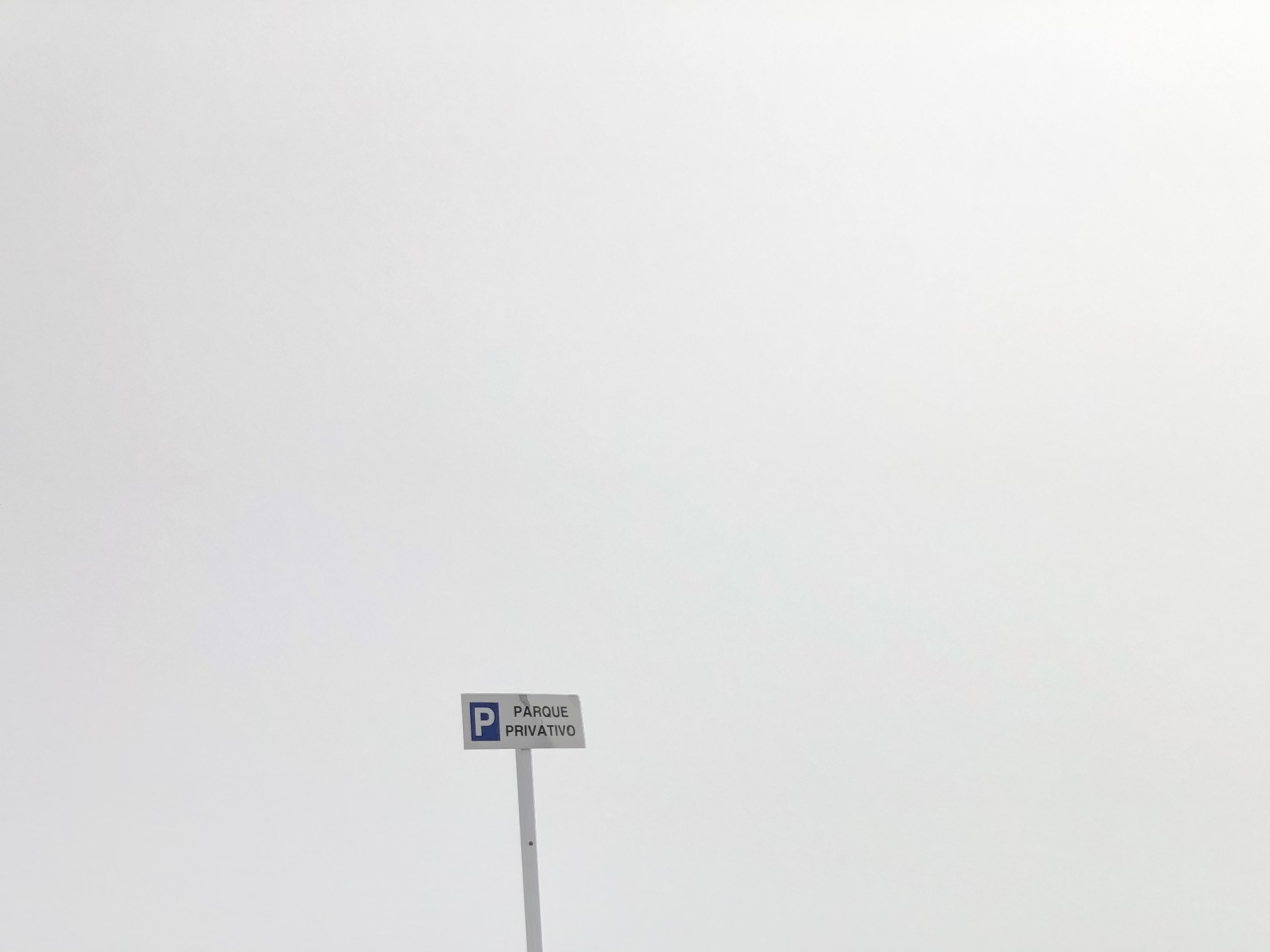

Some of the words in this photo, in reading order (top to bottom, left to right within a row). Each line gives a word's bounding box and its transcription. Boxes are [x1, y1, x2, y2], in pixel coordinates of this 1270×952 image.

[513, 705, 569, 718] PARQUE
[474, 707, 495, 736] P
[505, 724, 576, 737] PRIVATIVO
